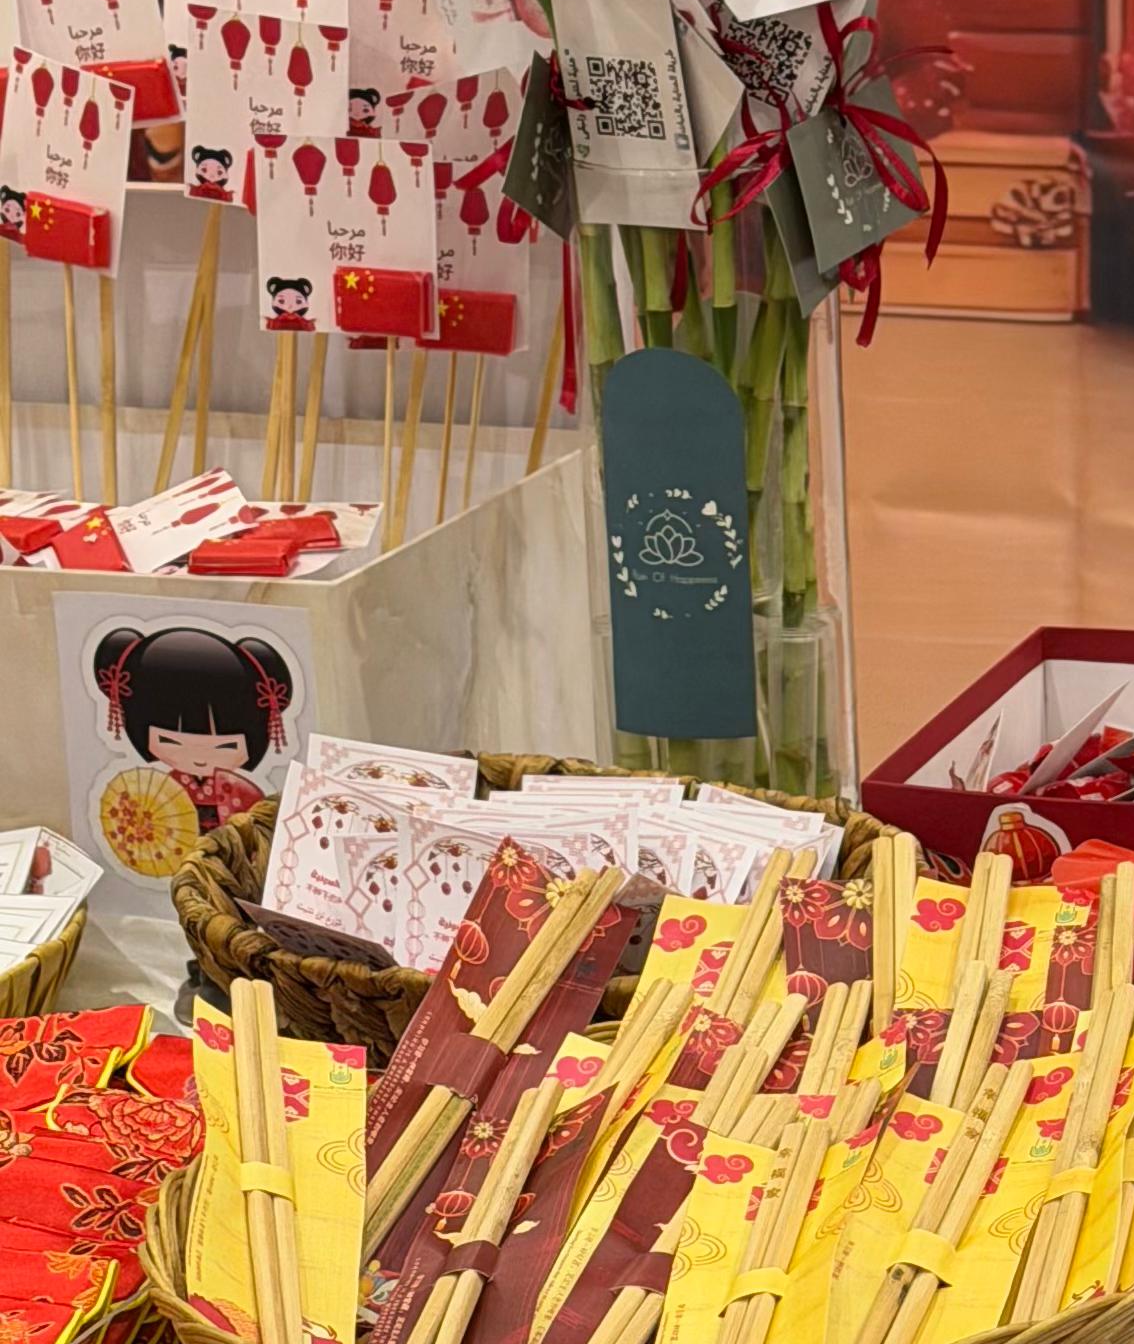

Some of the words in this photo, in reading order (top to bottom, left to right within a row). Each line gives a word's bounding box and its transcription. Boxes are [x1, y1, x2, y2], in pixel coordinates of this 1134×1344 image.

[67, 25, 103, 40] مرحبا
[75, 42, 105, 62] 你好
[400, 36, 437, 54] مرحبا
[400, 57, 435, 76] 你好
[249, 96, 283, 116] مرحبا
[46, 144, 73, 168] مرحبا
[327, 220, 366, 239] مرحبا
[329, 242, 366, 262] 你好
[437, 263, 455, 281] 好
